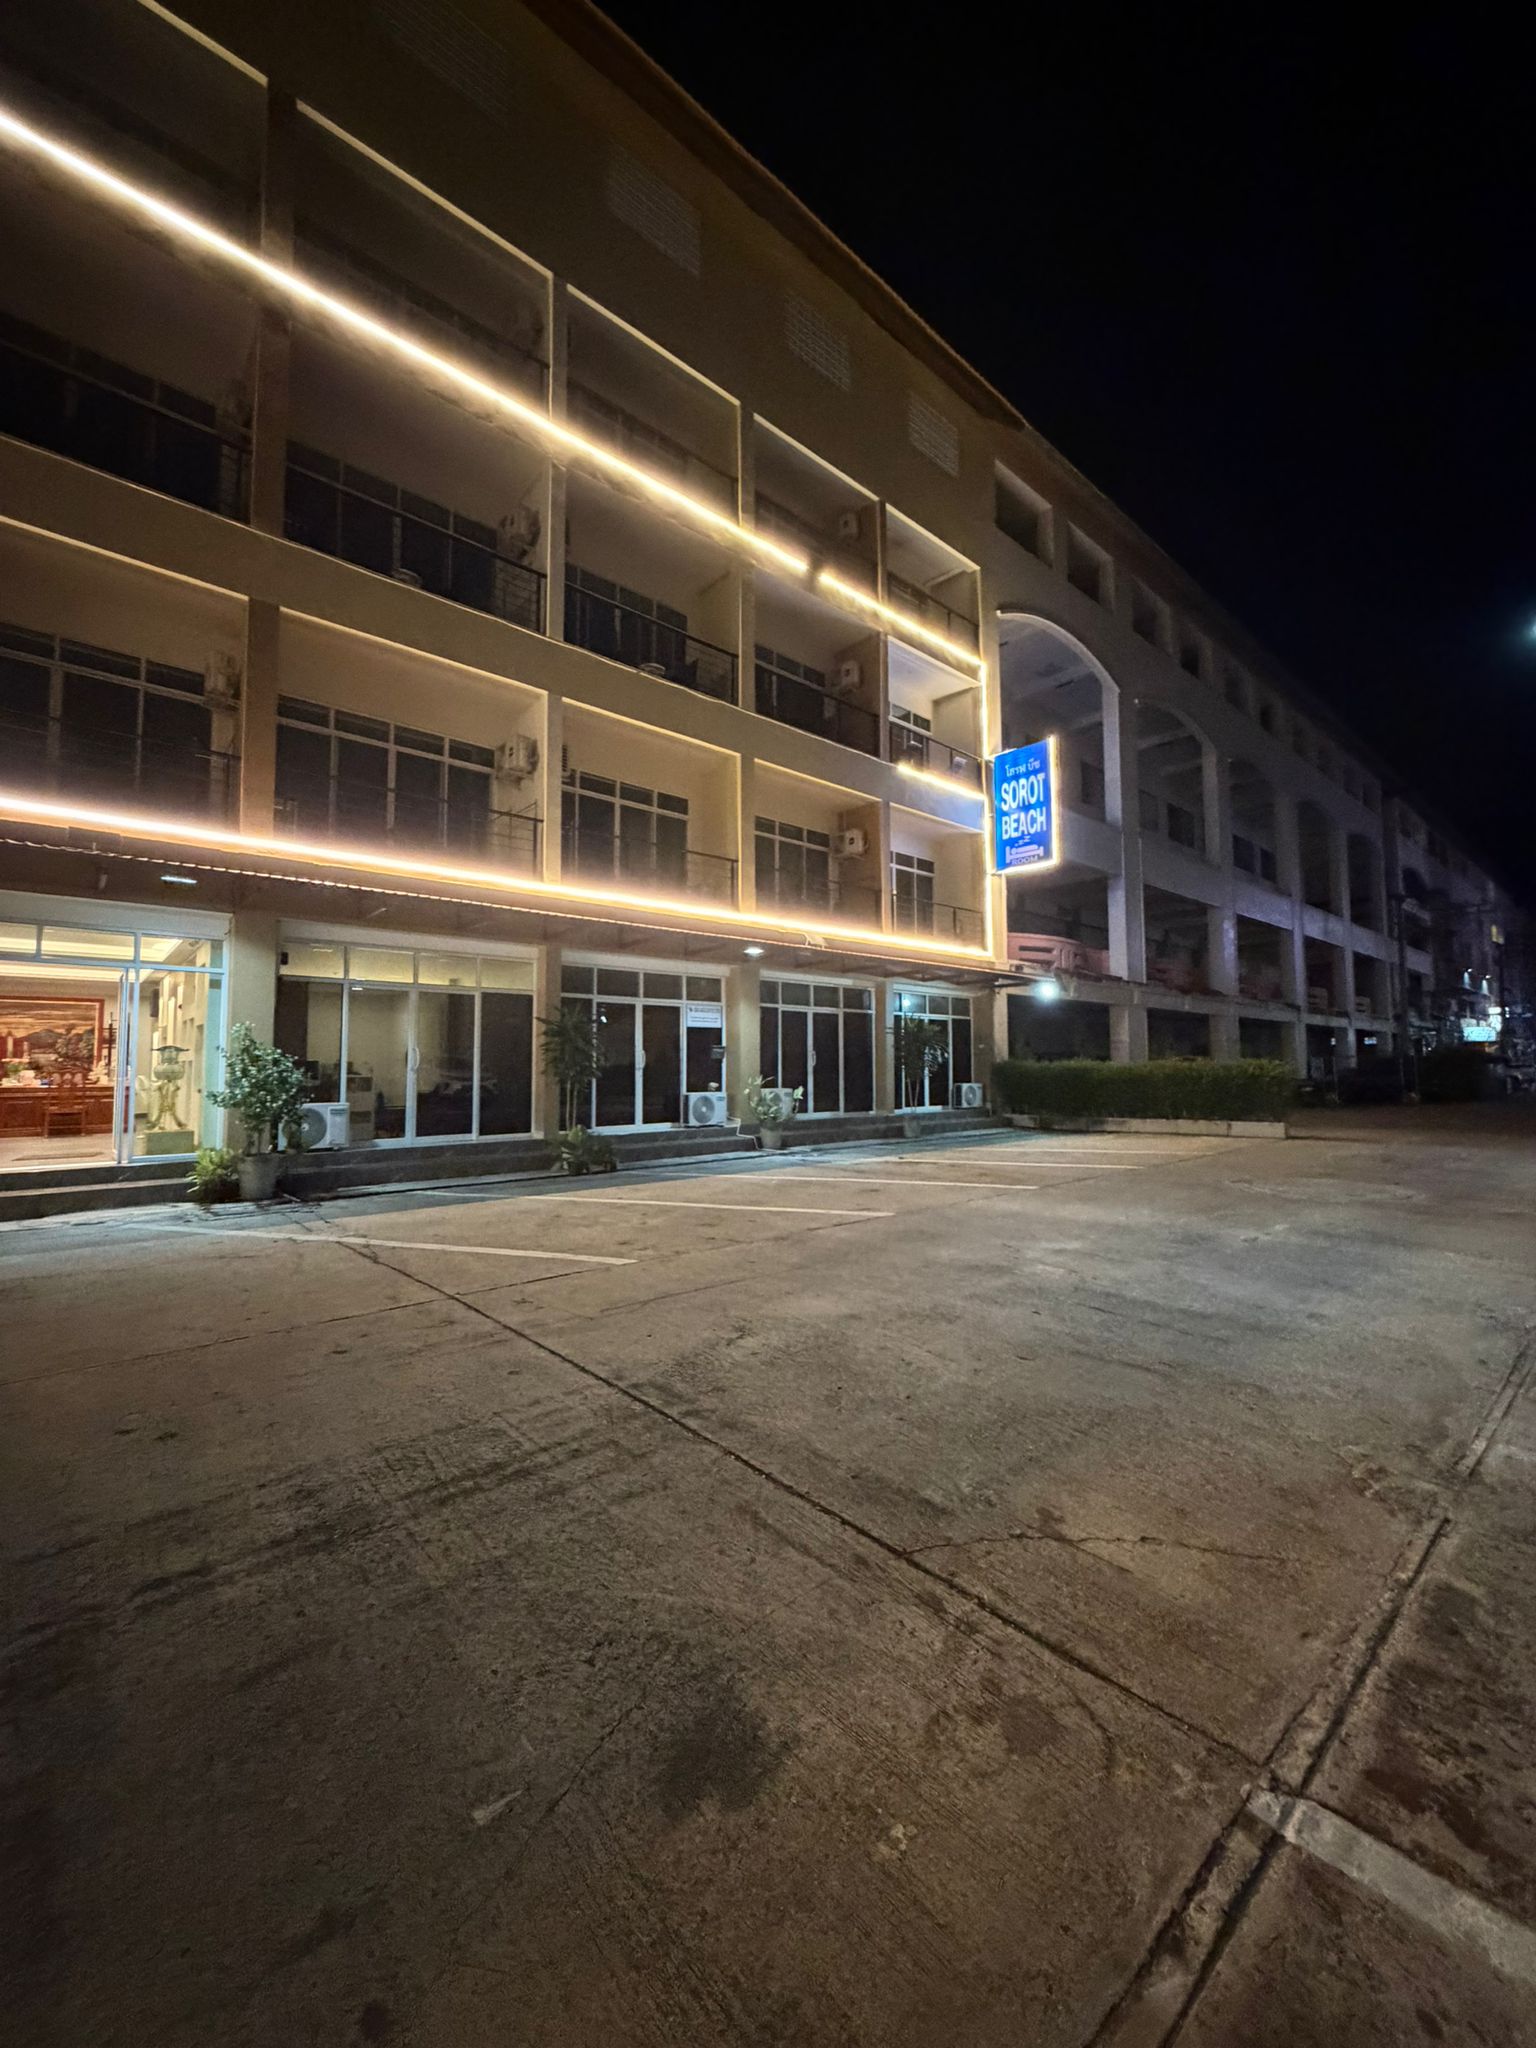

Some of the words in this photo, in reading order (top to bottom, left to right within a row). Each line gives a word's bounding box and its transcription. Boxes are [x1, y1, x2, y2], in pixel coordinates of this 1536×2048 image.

[1001, 773, 1046, 811] SOROT
[1002, 807, 1047, 840] BEACH
[1011, 855, 1038, 865] ROOM
